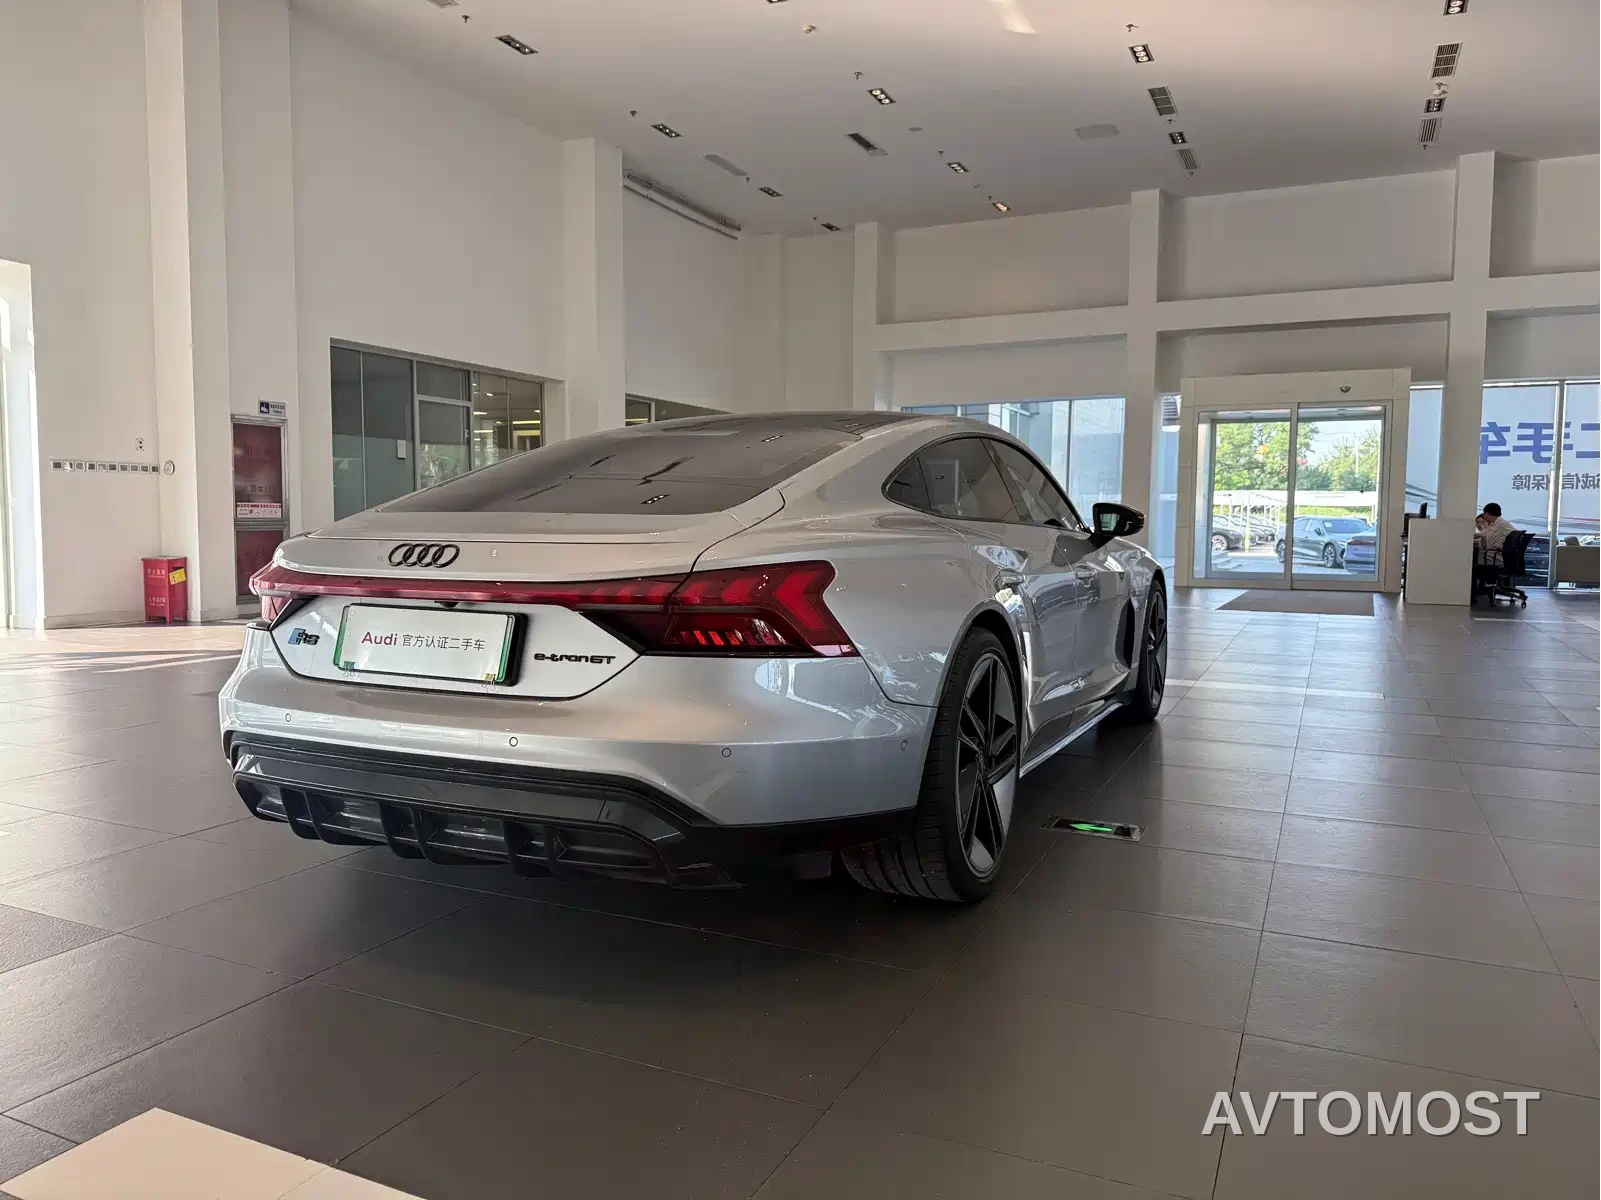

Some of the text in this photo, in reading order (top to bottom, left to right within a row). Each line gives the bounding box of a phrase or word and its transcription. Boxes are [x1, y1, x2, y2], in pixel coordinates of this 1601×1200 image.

[361, 631, 486, 652] Audi 官方认证二手车
